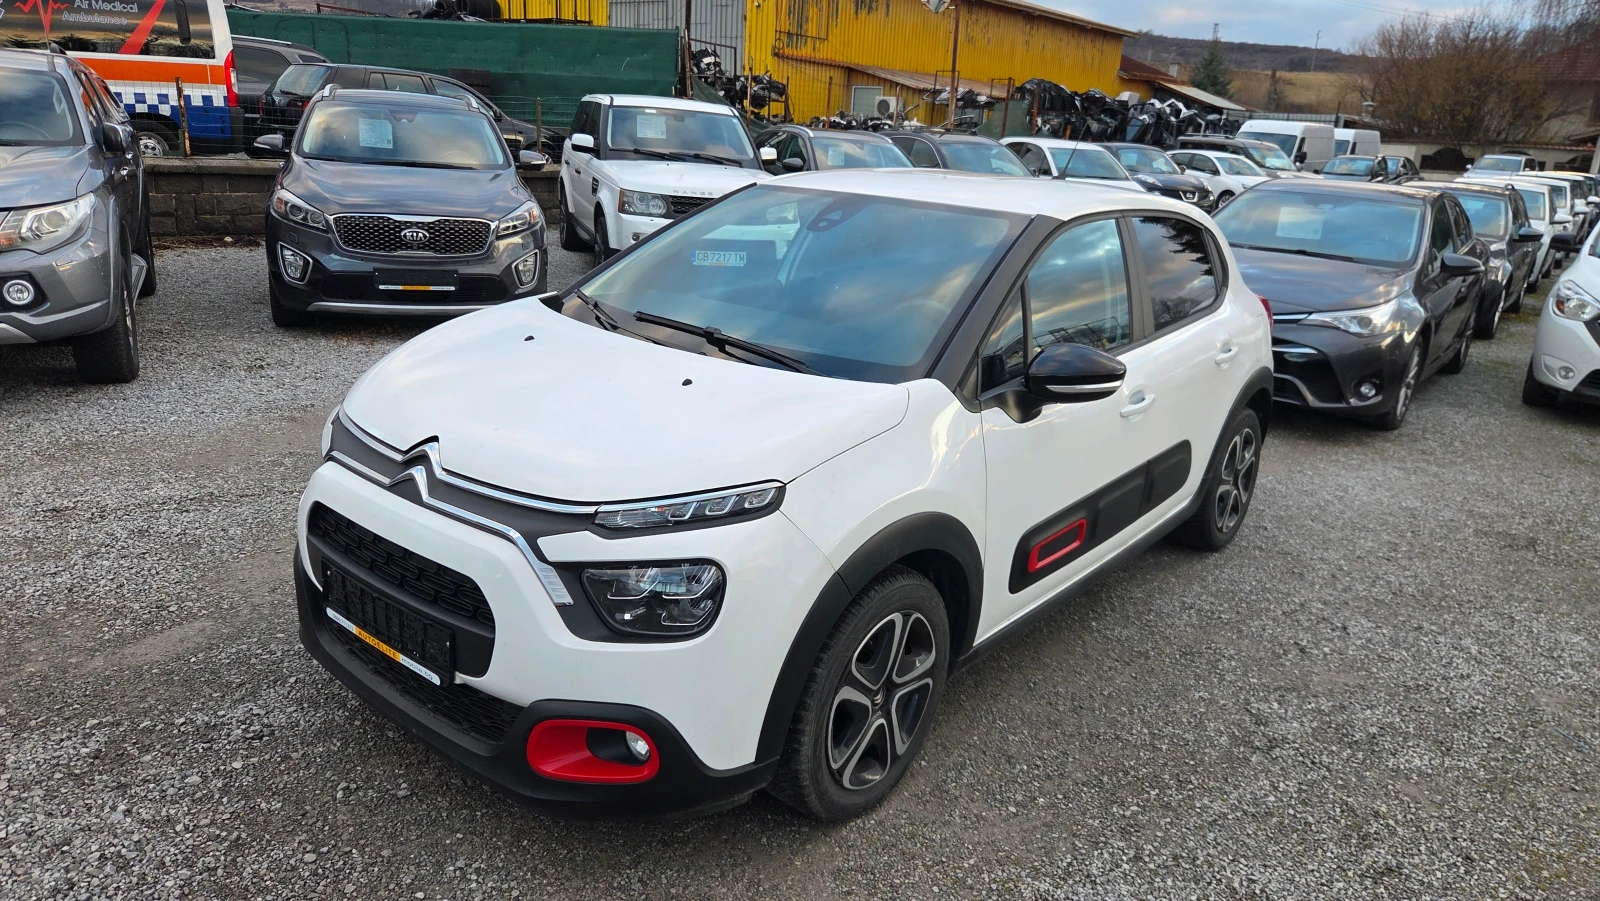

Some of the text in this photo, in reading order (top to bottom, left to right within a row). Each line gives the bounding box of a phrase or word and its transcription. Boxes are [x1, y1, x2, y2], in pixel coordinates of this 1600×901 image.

[92, 0, 138, 13] Medical
[62, 11, 127, 25] Ambulance
[406, 232, 425, 241] KIA
[697, 251, 745, 263] CB 7217 TM
[358, 630, 397, 658] AUTOELITE
